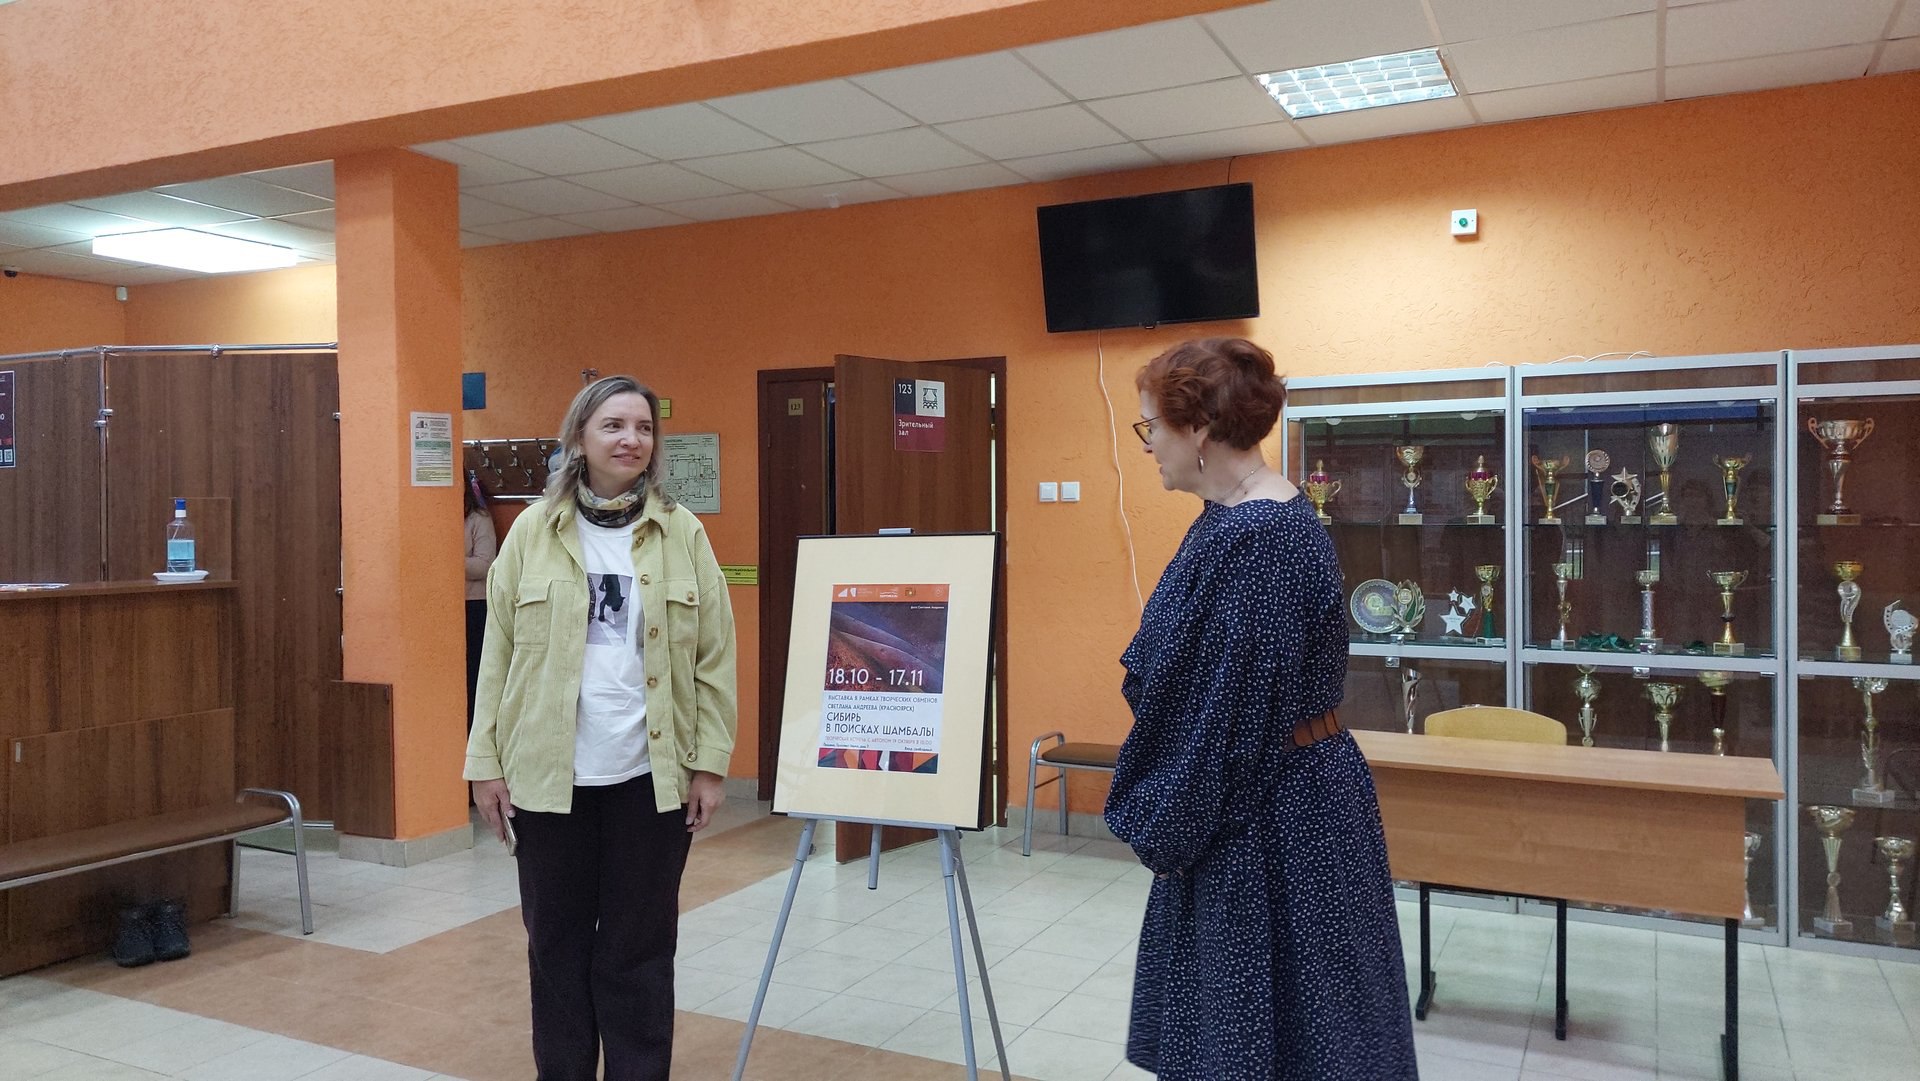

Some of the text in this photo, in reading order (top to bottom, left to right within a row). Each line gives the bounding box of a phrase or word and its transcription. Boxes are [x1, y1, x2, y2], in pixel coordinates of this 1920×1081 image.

[898, 384, 912, 394] 123
[898, 418, 934, 429] Зрительный
[829, 668, 869, 685] 18.10
[889, 669, 923, 686] 17.11
[878, 704, 915, 712] (КРАСНОЯРСК)
[826, 712, 861, 722] СИБИРЬ
[825, 723, 934, 737] В ПОИСКАХ ШАМБАЛЫ
